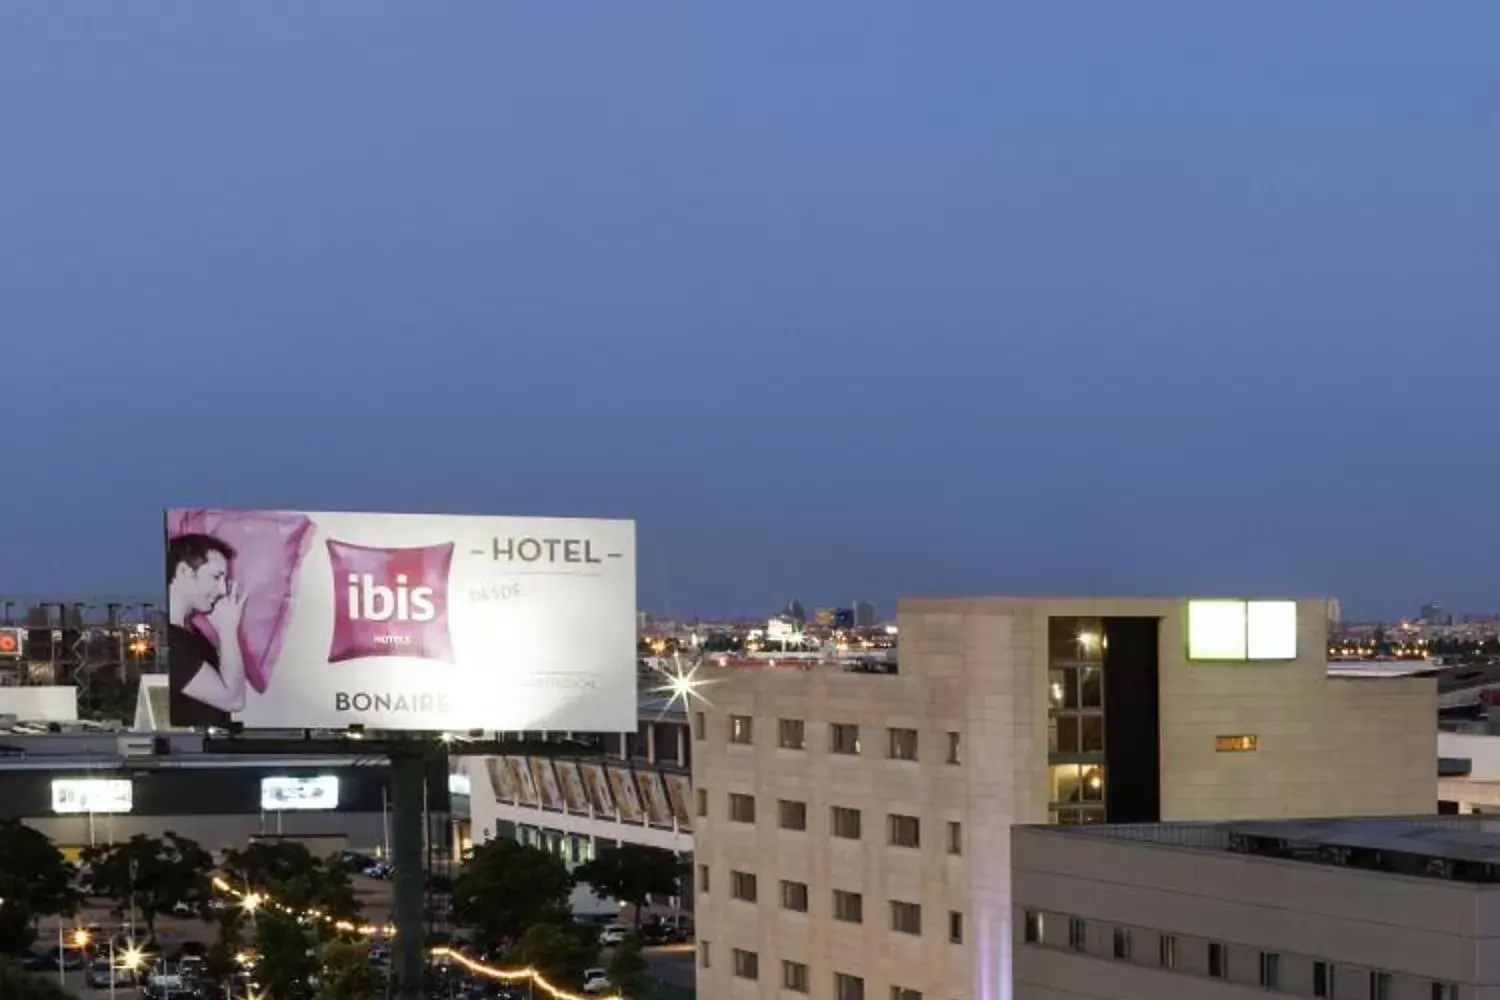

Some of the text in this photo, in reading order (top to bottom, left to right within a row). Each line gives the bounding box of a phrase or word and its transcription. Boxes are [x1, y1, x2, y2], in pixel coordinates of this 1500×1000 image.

[492, 537, 602, 564] HOTEL
[347, 573, 435, 622] ibis
[335, 691, 451, 713] BONAIRE
